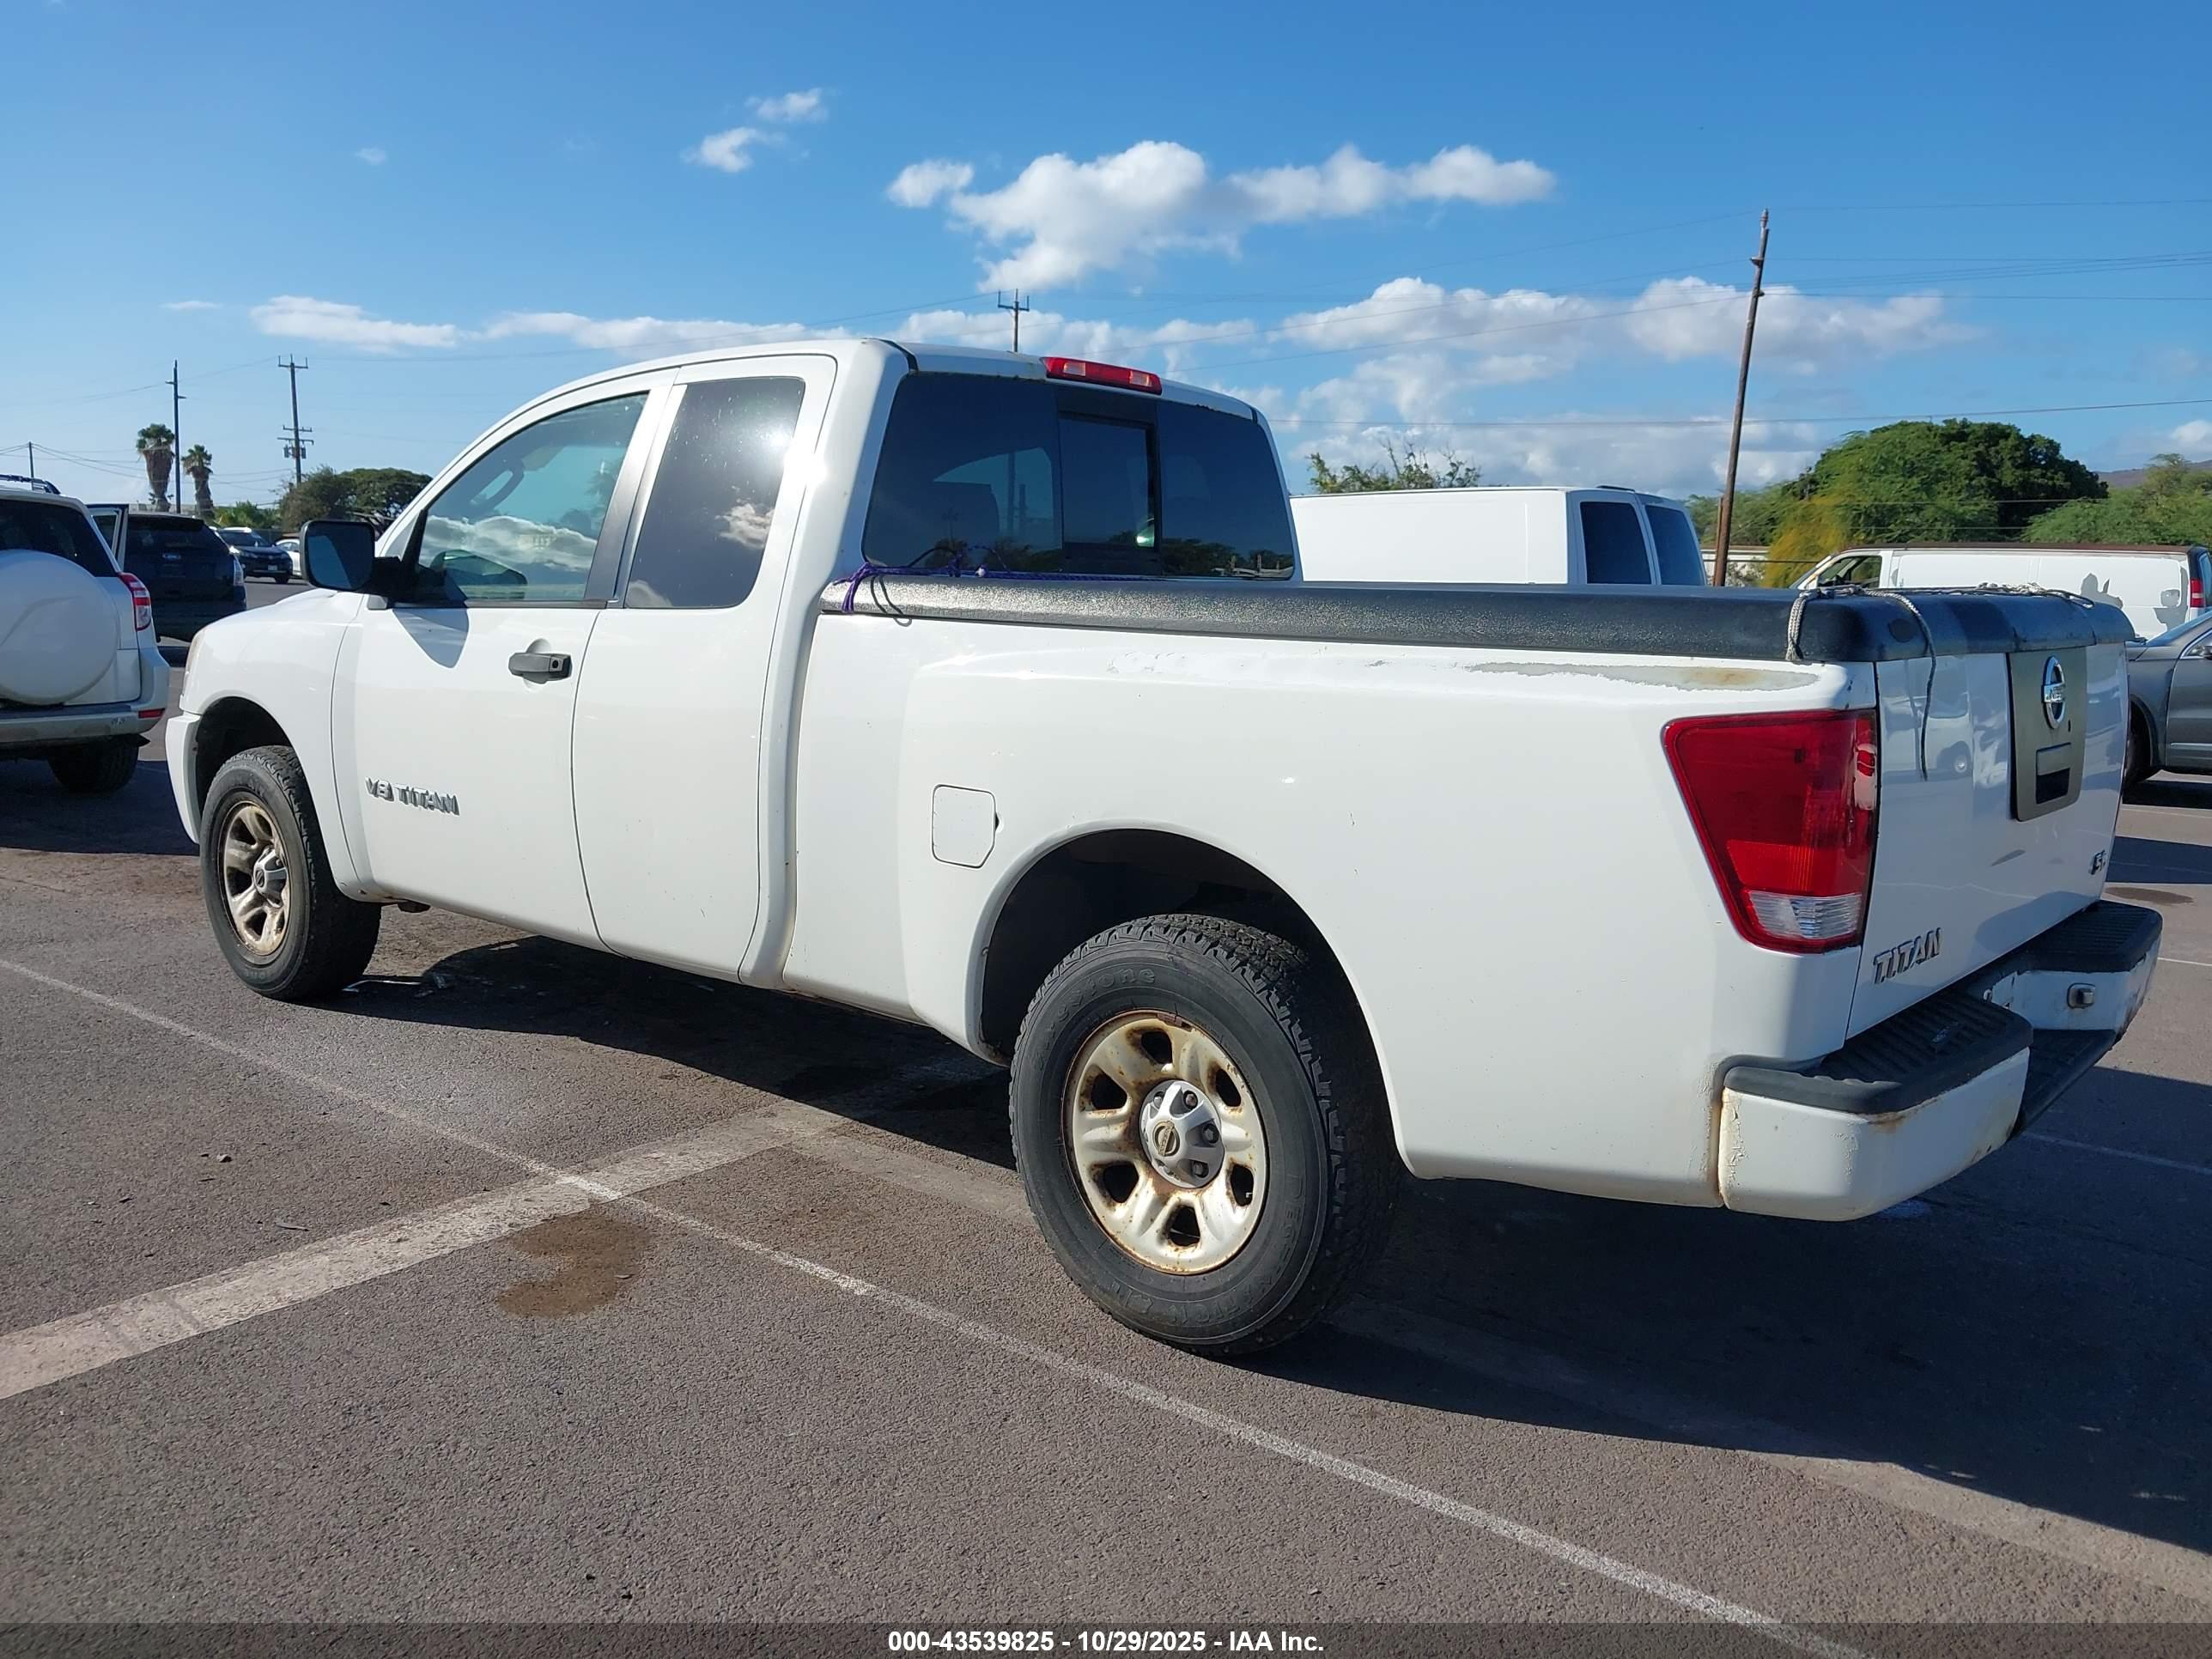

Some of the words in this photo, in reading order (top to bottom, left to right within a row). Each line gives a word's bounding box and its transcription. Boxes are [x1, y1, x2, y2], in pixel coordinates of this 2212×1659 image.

[365, 776, 394, 802] V8
[395, 783, 460, 816] TITAN
[1873, 927, 1942, 985] TITAN
